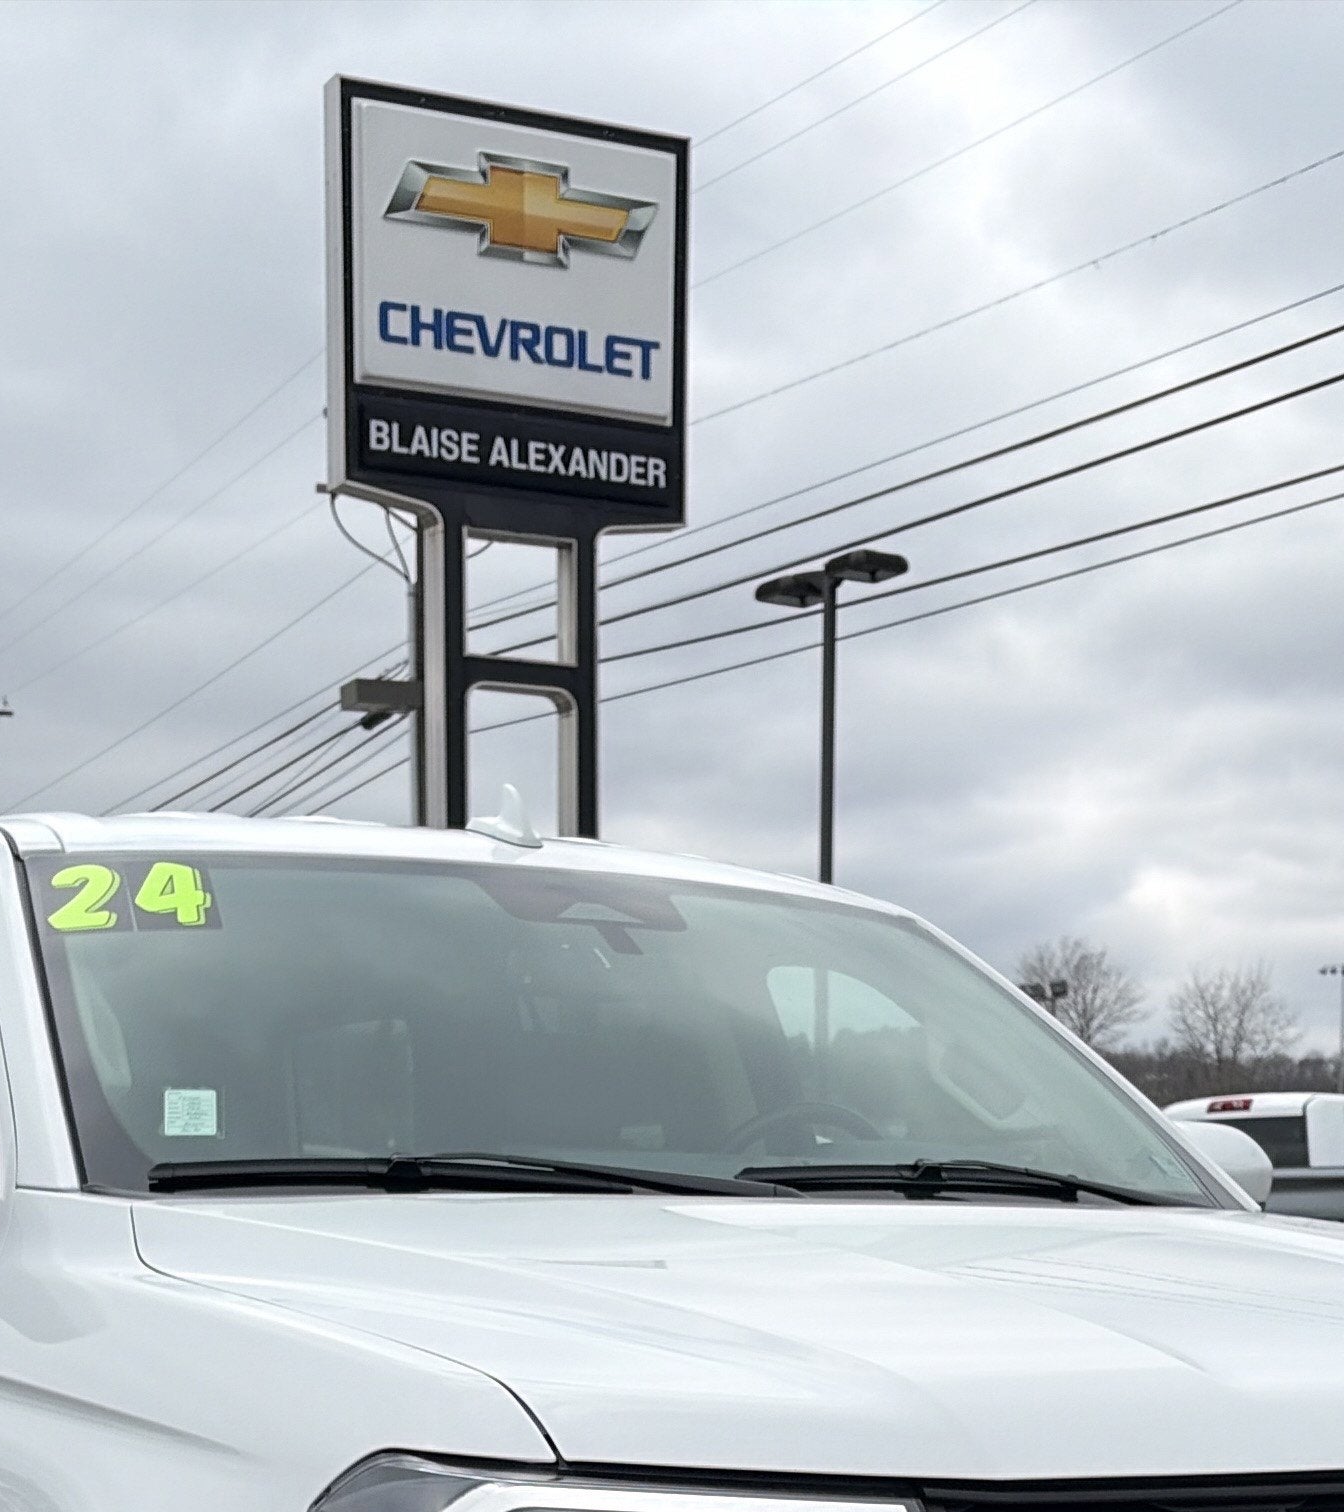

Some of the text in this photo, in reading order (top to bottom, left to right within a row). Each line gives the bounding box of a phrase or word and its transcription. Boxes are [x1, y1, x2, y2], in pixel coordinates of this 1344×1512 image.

[379, 301, 660, 381] CHEVROLET
[369, 419, 667, 489] BLAISE ALEXANDER
[47, 862, 211, 931] 24
